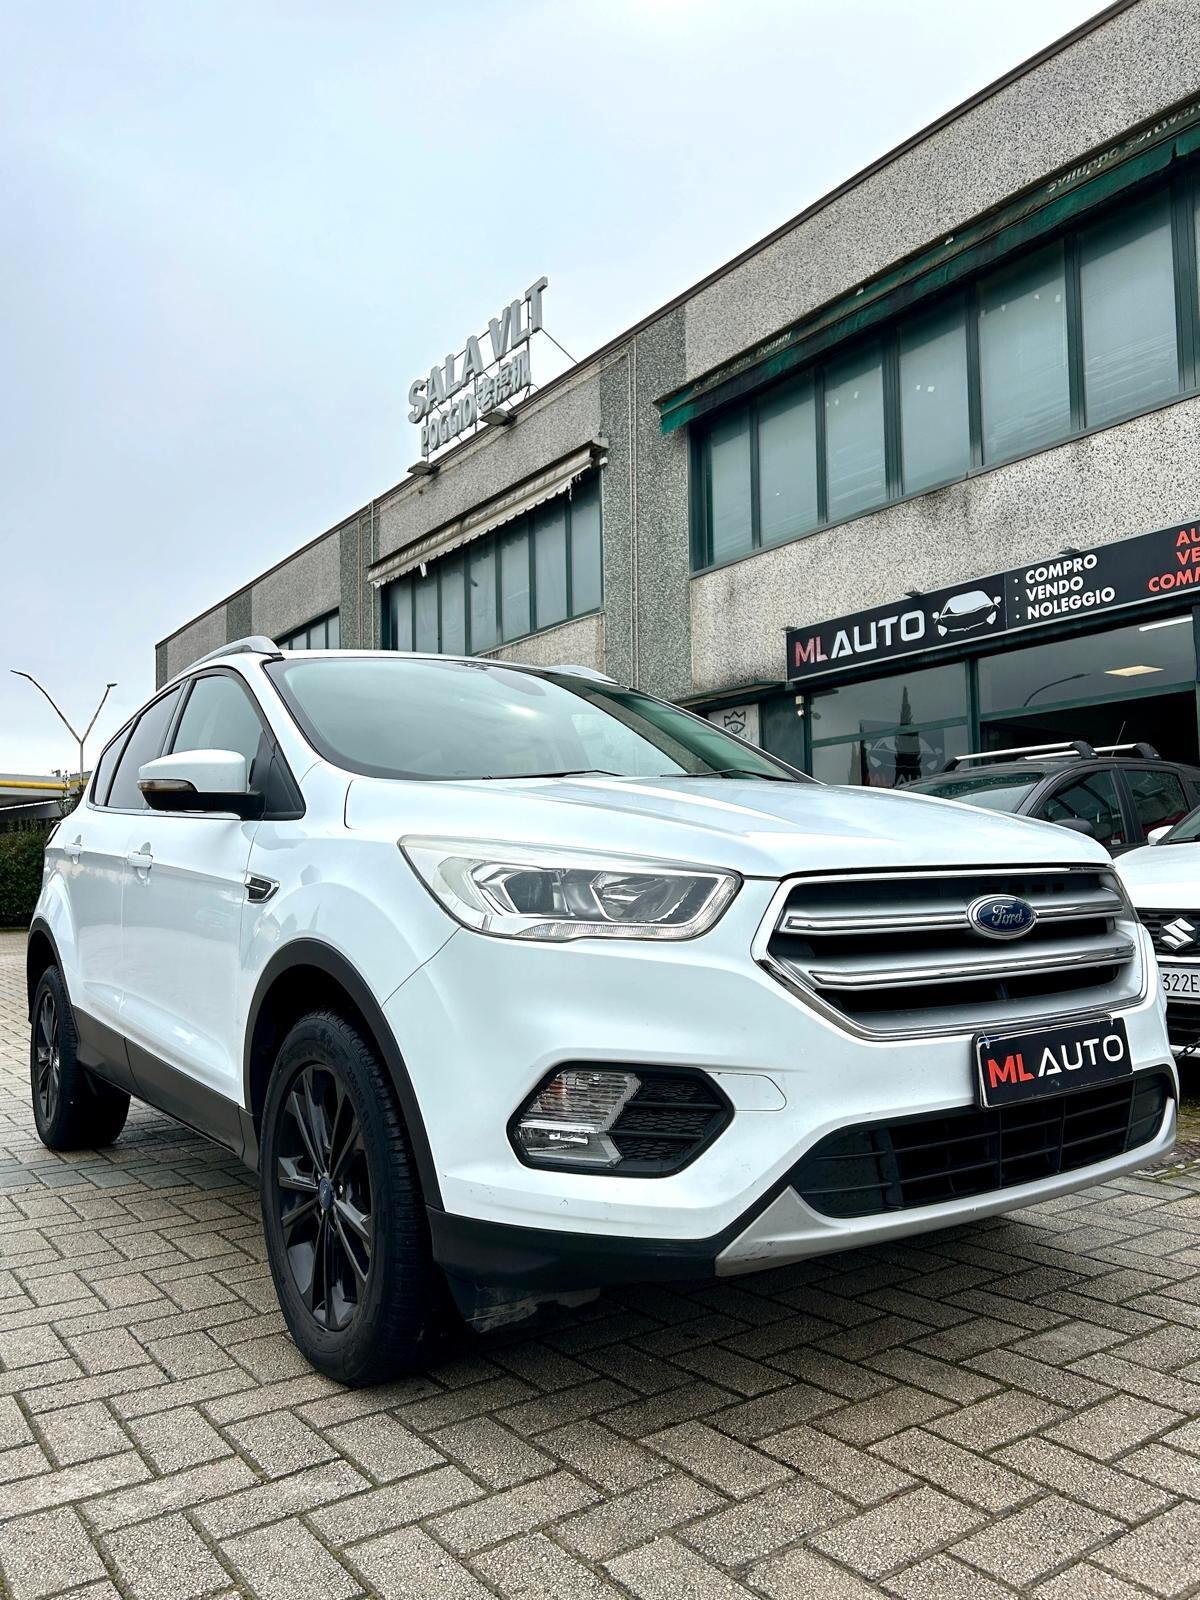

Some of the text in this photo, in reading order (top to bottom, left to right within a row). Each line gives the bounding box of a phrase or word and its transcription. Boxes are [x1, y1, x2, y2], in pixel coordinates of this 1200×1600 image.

[408, 276, 548, 424] SALA VLT
[421, 350, 531, 457] POGGIO 老虎机
[1025, 554, 1098, 584] COMPRO
[1025, 576, 1084, 602] VENDO
[1027, 586, 1116, 620] NOLEGGIO
[795, 609, 926, 668] ML AUTO
[991, 904, 1025, 926] Ford
[1162, 972, 1200, 993] 322E
[987, 1034, 1124, 1089] ML AUTO
